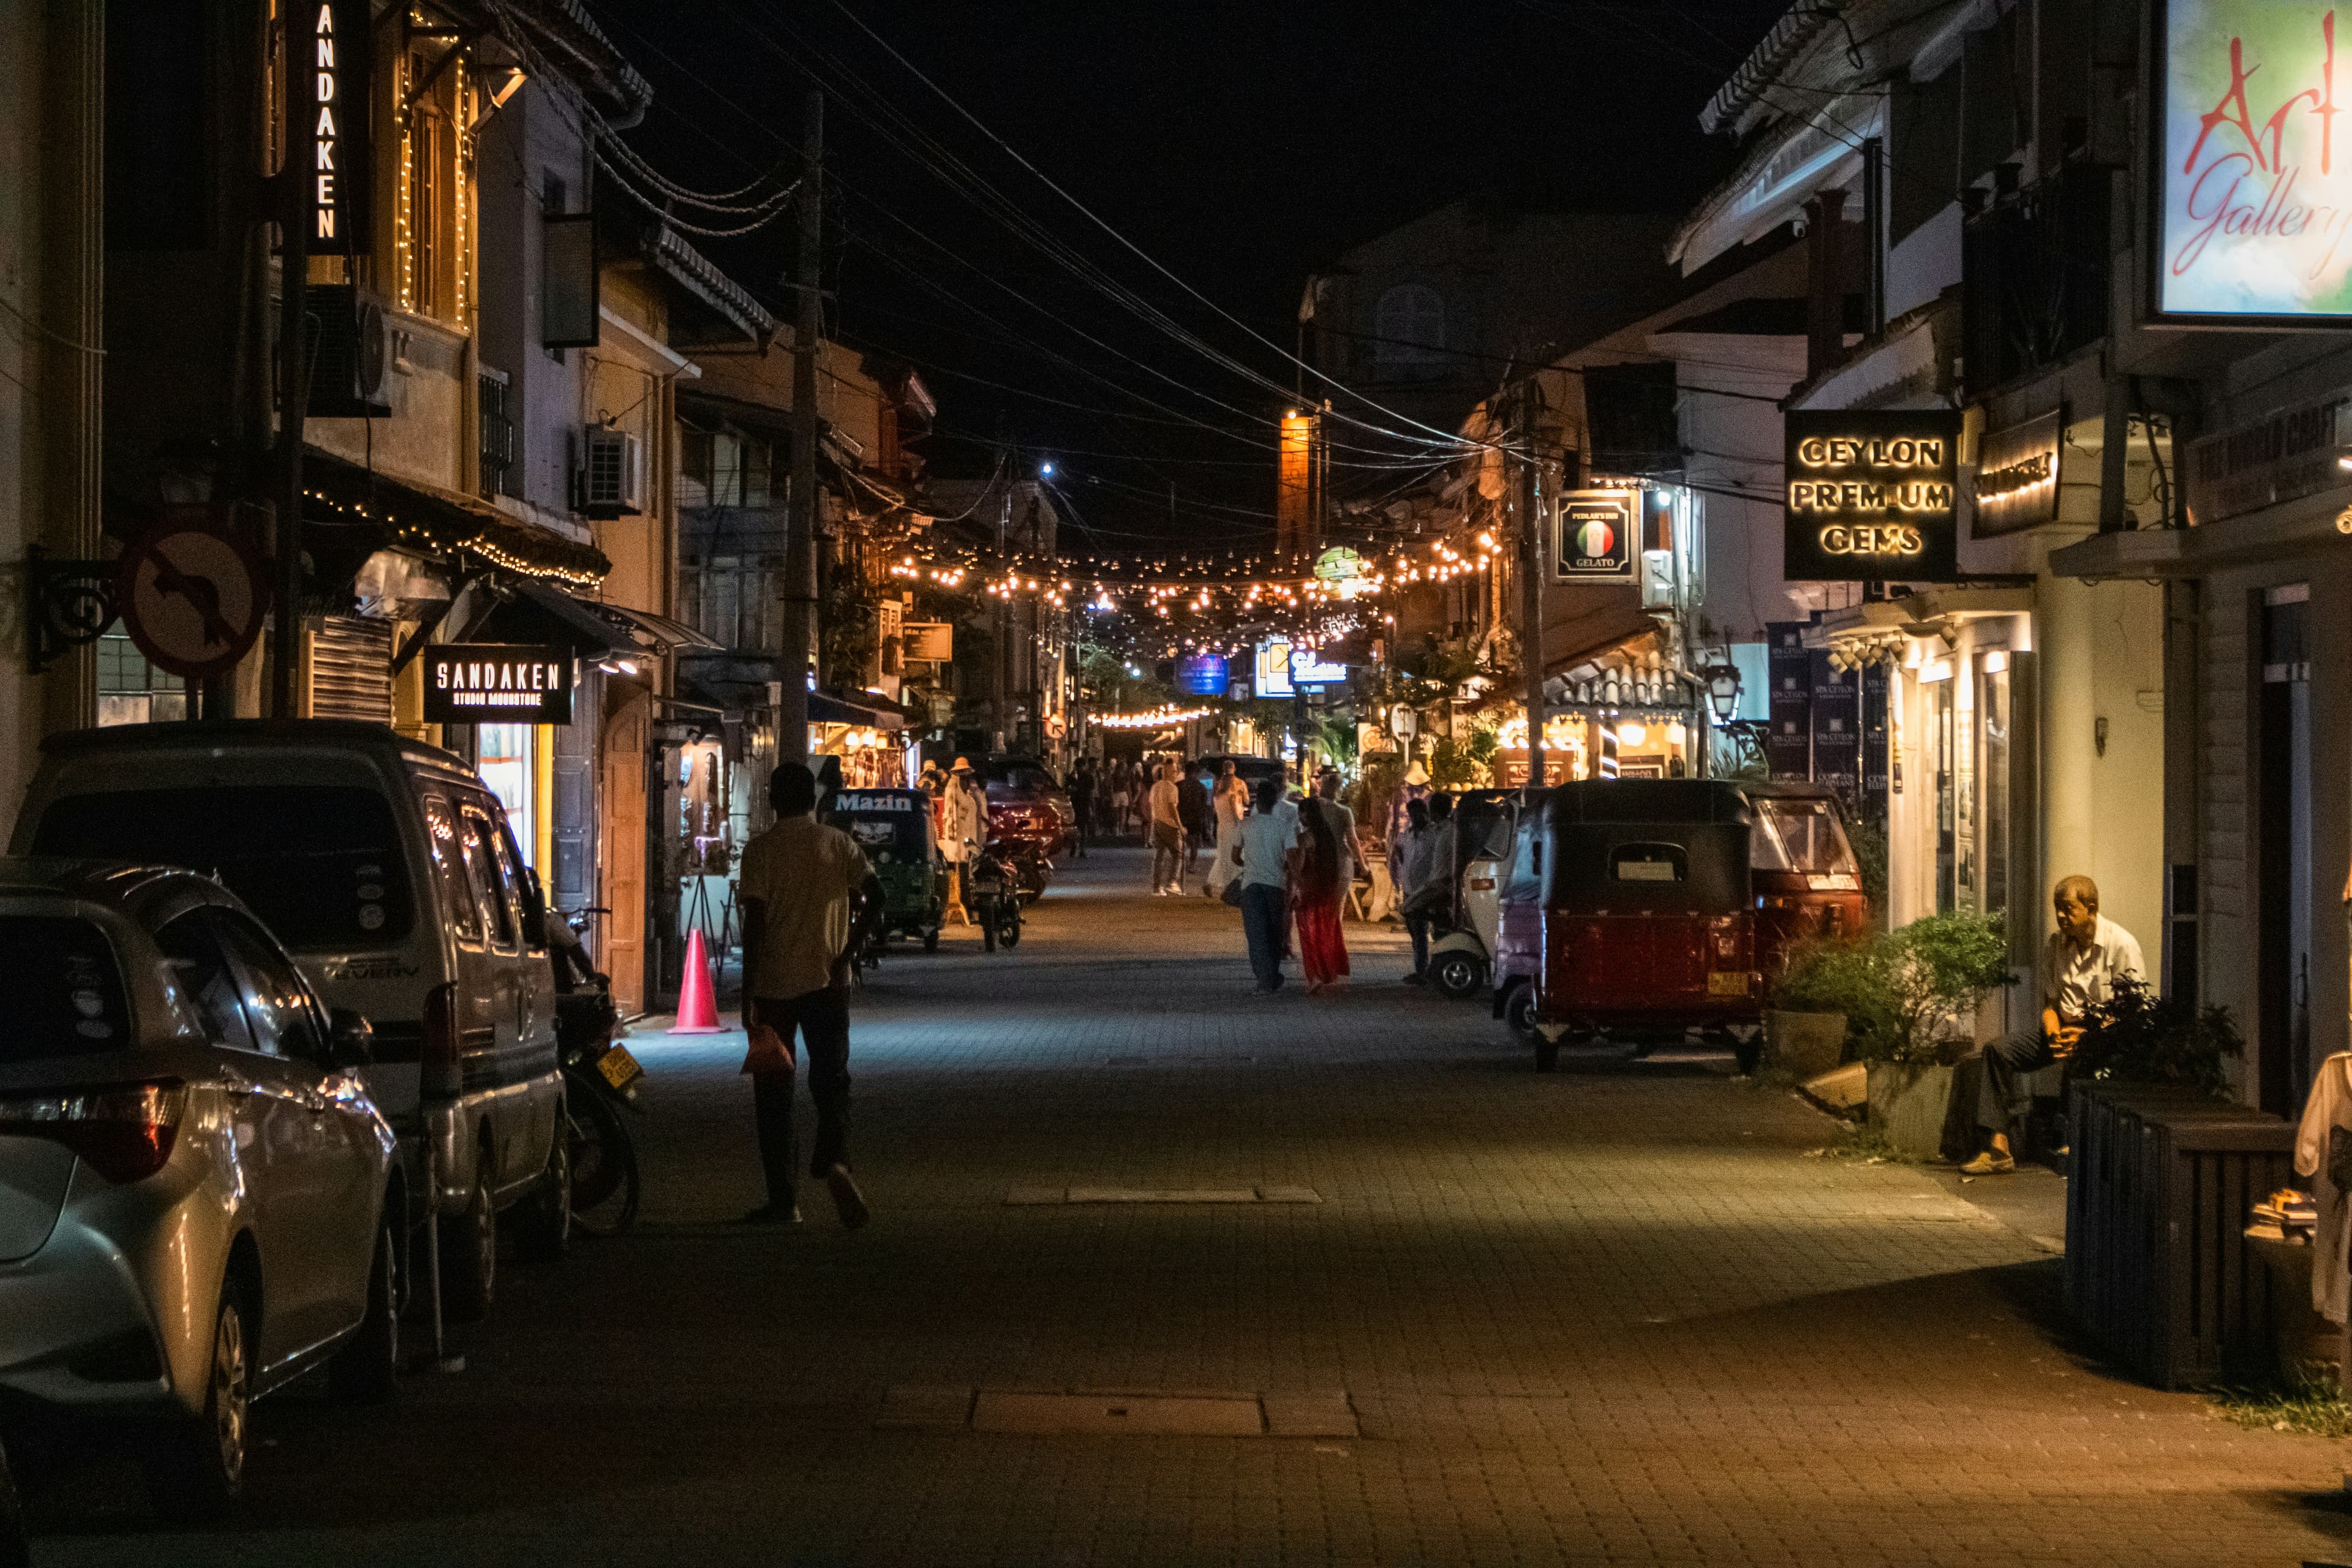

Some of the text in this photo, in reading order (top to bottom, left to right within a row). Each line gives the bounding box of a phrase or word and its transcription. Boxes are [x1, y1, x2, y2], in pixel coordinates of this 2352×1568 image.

[2184, 9, 2345, 176] Art
[2172, 152, 2352, 281] Gallery
[1799, 437, 1943, 469] CEYLON
[1791, 481, 1953, 511] PREMUM
[1822, 525, 1923, 554] GEMS
[1576, 558, 1615, 567] GELATO
[437, 662, 560, 690] SANDAKEN
[453, 692, 486, 705] STUDIO
[835, 794, 913, 812] Mazin
